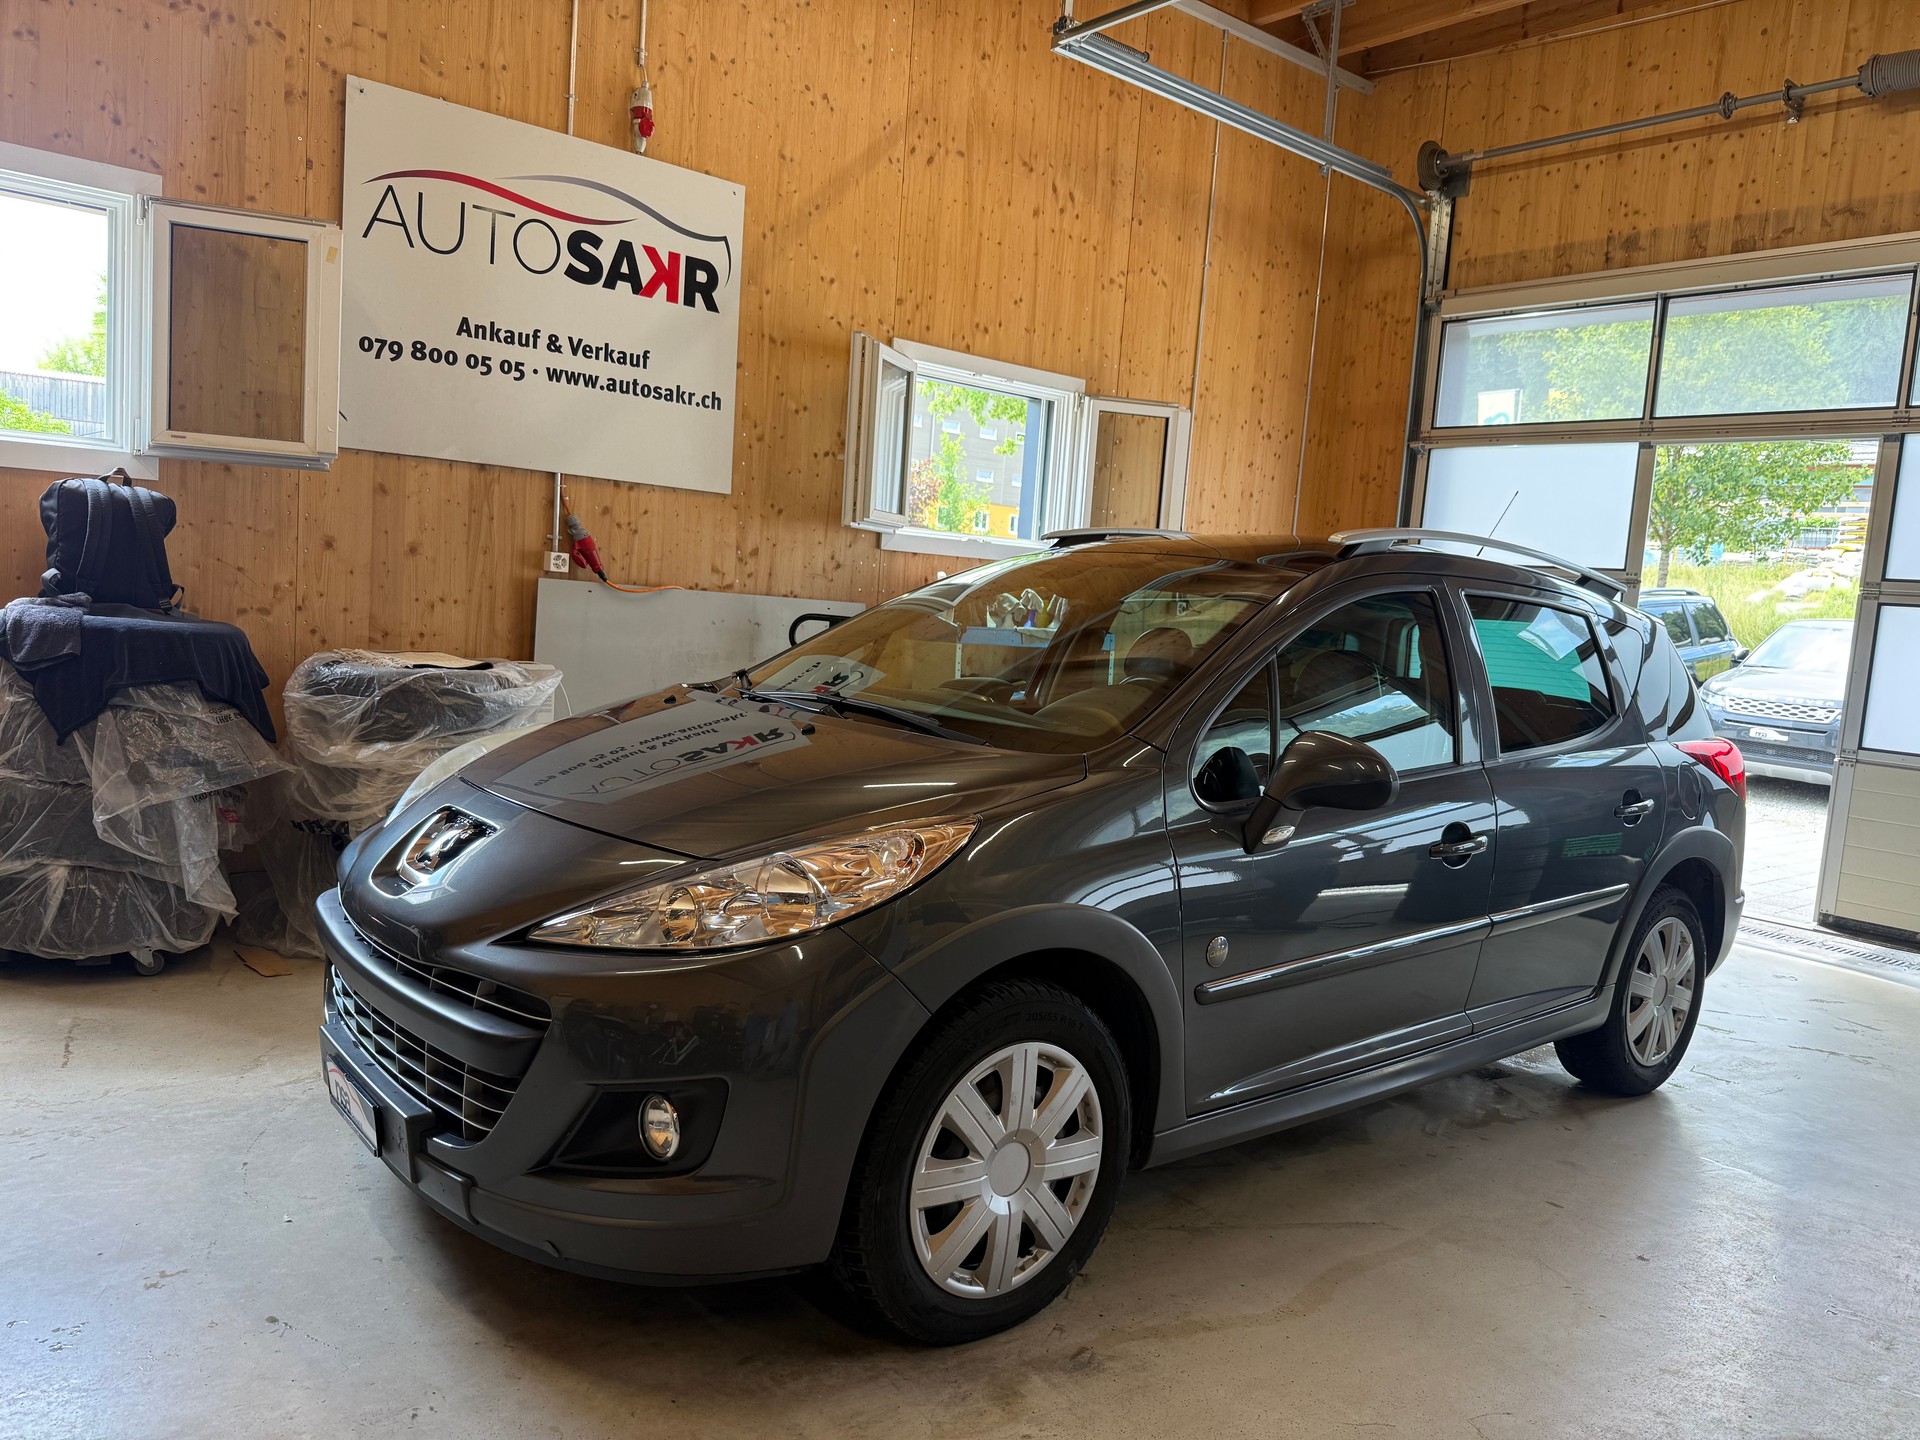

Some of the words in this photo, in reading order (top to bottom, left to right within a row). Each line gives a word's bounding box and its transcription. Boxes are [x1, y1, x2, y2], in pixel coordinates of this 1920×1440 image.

[362, 185, 720, 314] AUTOSAKR
[358, 336, 404, 362] 079
[410, 340, 458, 366] 800
[465, 354, 493, 376] 05
[499, 359, 526, 381] 05
[545, 366, 722, 411] www.autosakr.ch
[456, 317, 541, 349] Ankauf
[546, 334, 564, 354] &
[568, 336, 651, 369] Verkauf
